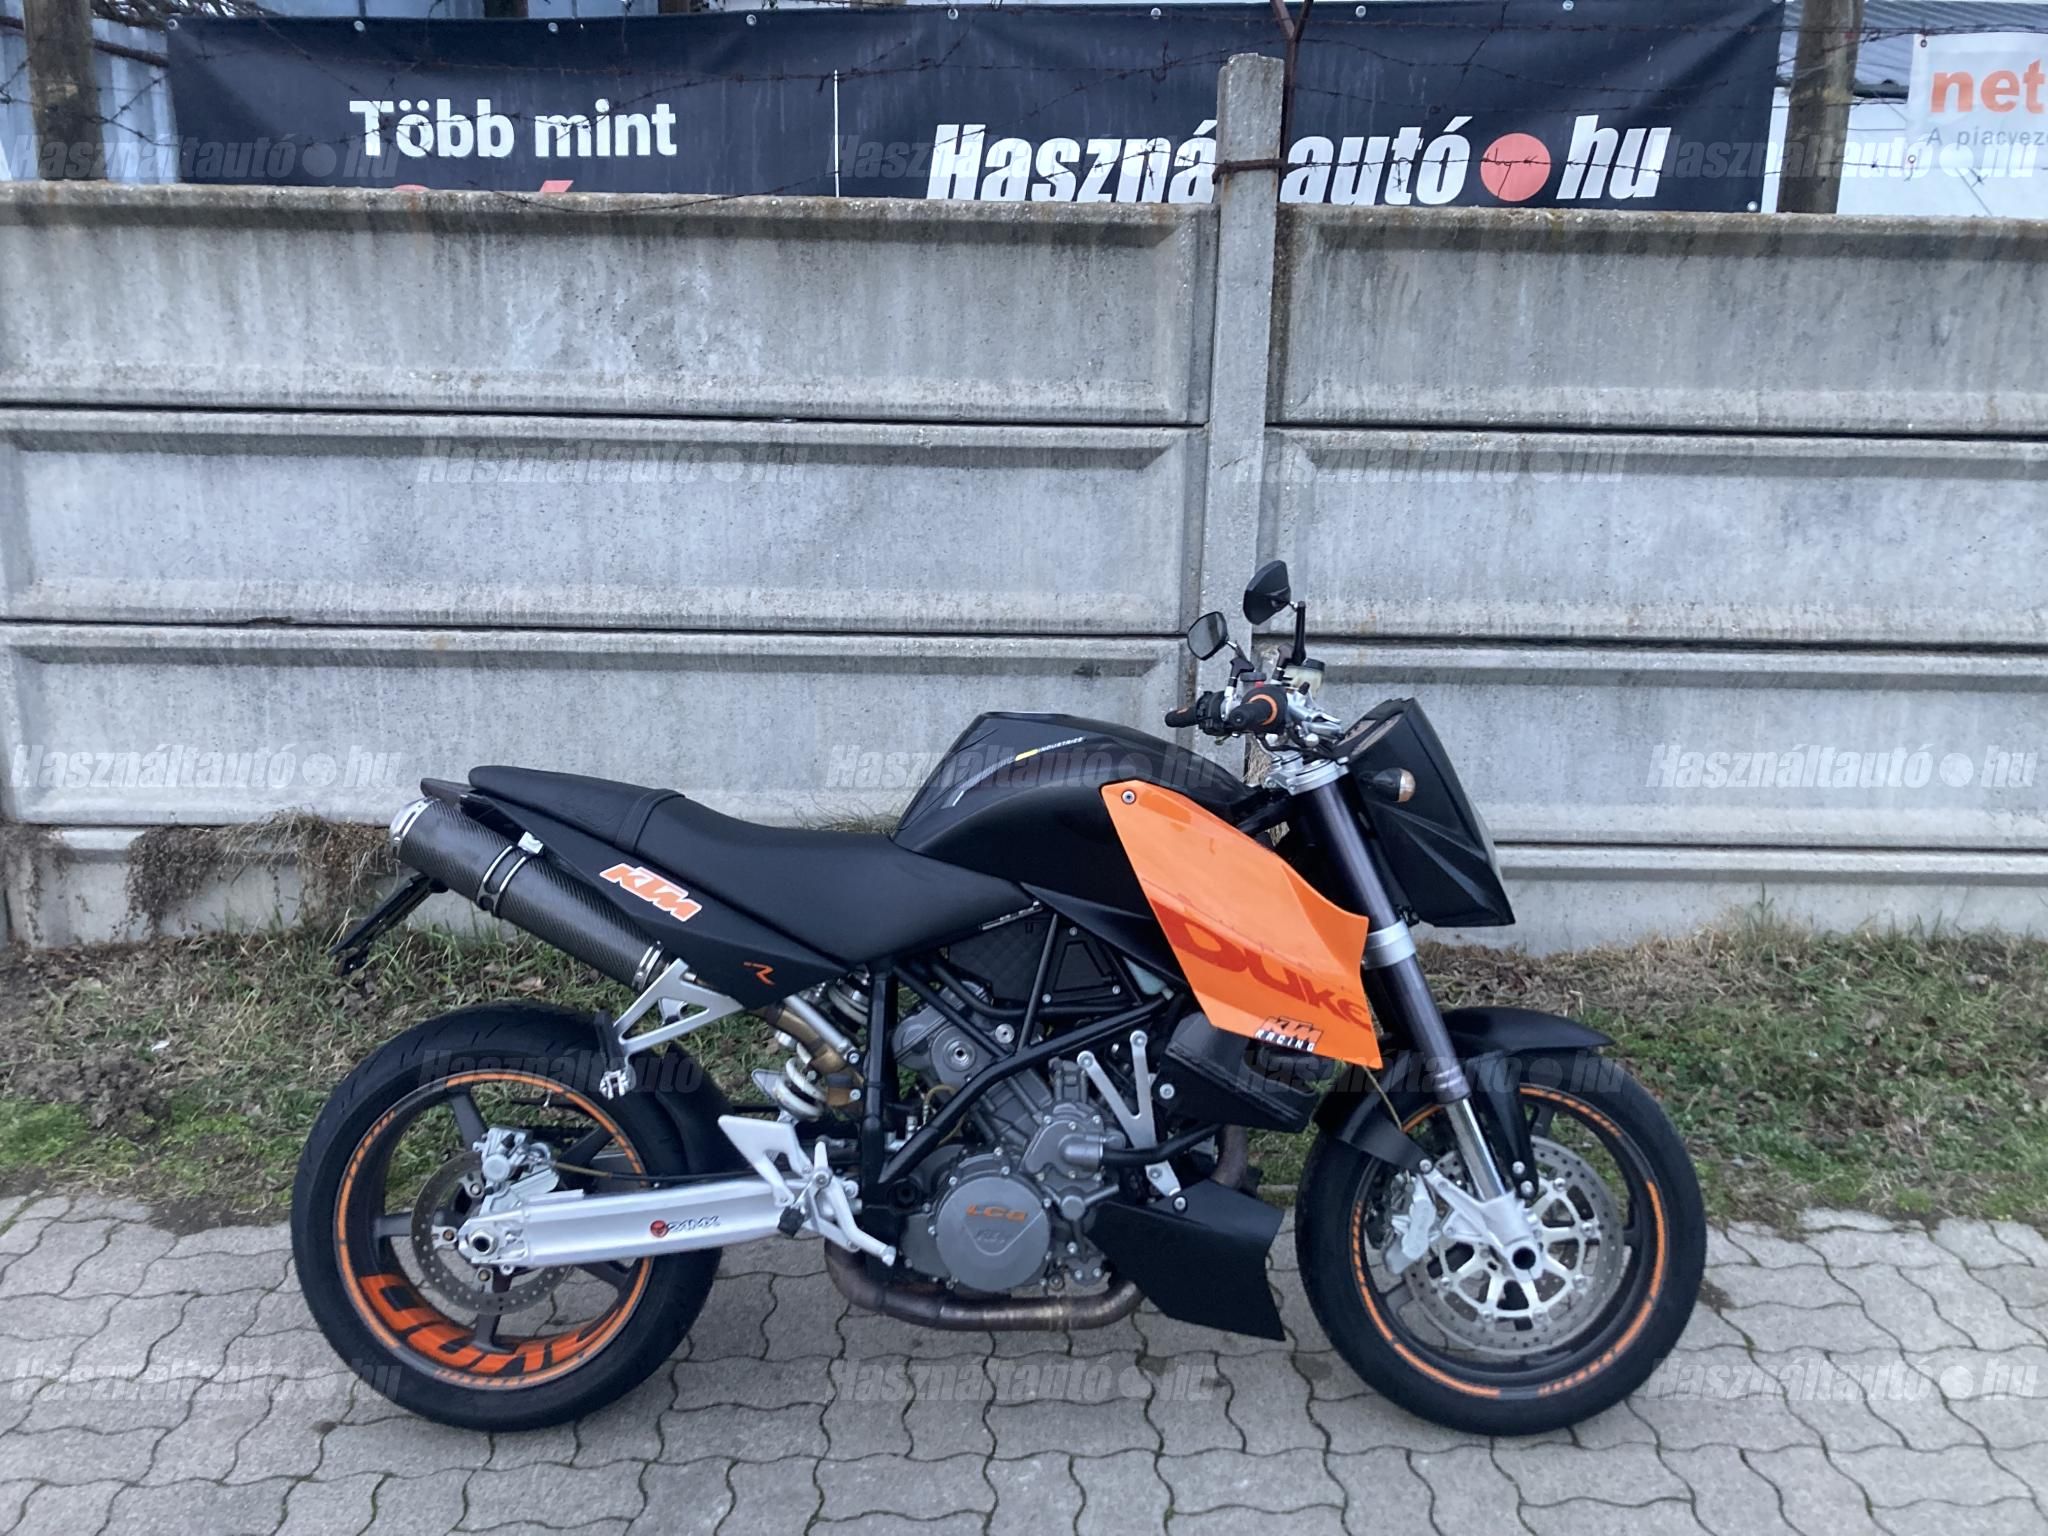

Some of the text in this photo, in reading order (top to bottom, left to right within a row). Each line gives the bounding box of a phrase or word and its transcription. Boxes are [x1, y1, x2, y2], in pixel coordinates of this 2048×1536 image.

[1930, 58, 2046, 114] net
[349, 99, 678, 158] Több mint
[1926, 126, 2048, 151] A piacvez
[600, 863, 702, 922] KTM
[1254, 1028, 1316, 1053] RACING
